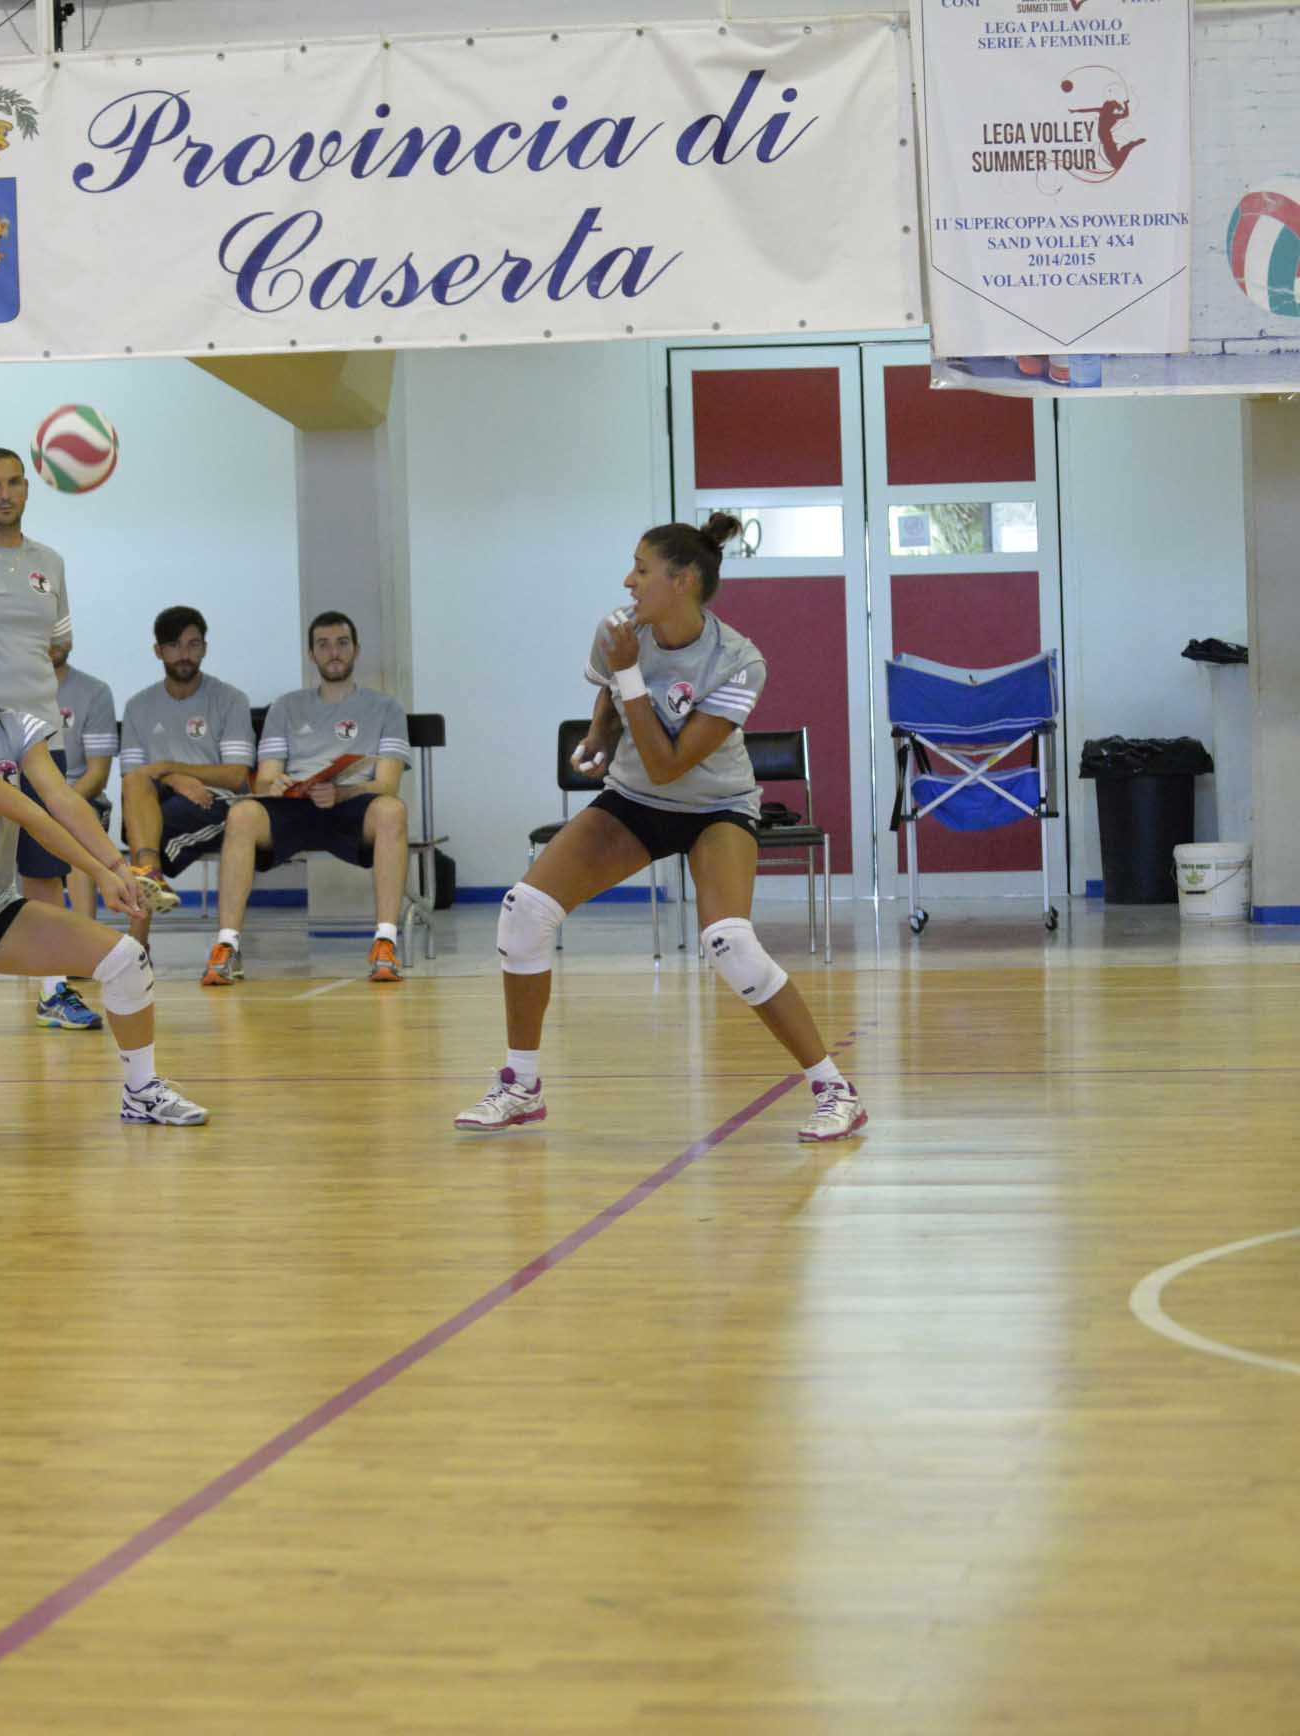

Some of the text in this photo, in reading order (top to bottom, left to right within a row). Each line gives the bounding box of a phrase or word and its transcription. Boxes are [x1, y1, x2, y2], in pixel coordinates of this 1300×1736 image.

[1016, 2, 1069, 14] SUMMER TOUR
[984, 18, 1123, 34] LEGA PALLAVOLO
[978, 33, 1131, 50] SERIE A FEMMINILE
[71, 70, 821, 194] Provincia di
[983, 121, 1094, 145] LEGA VOLLEY
[972, 148, 1096, 173] SUMMER TOUR
[955, 215, 1056, 231] SUPERCOPPA
[1059, 214, 1079, 229] XS
[987, 233, 1135, 250] SAND VOLLEY 4X4
[217, 206, 686, 314] Caserta
[1027, 252, 1097, 267] 2014/2015
[982, 271, 1144, 289] VOLALTO CASERTA
